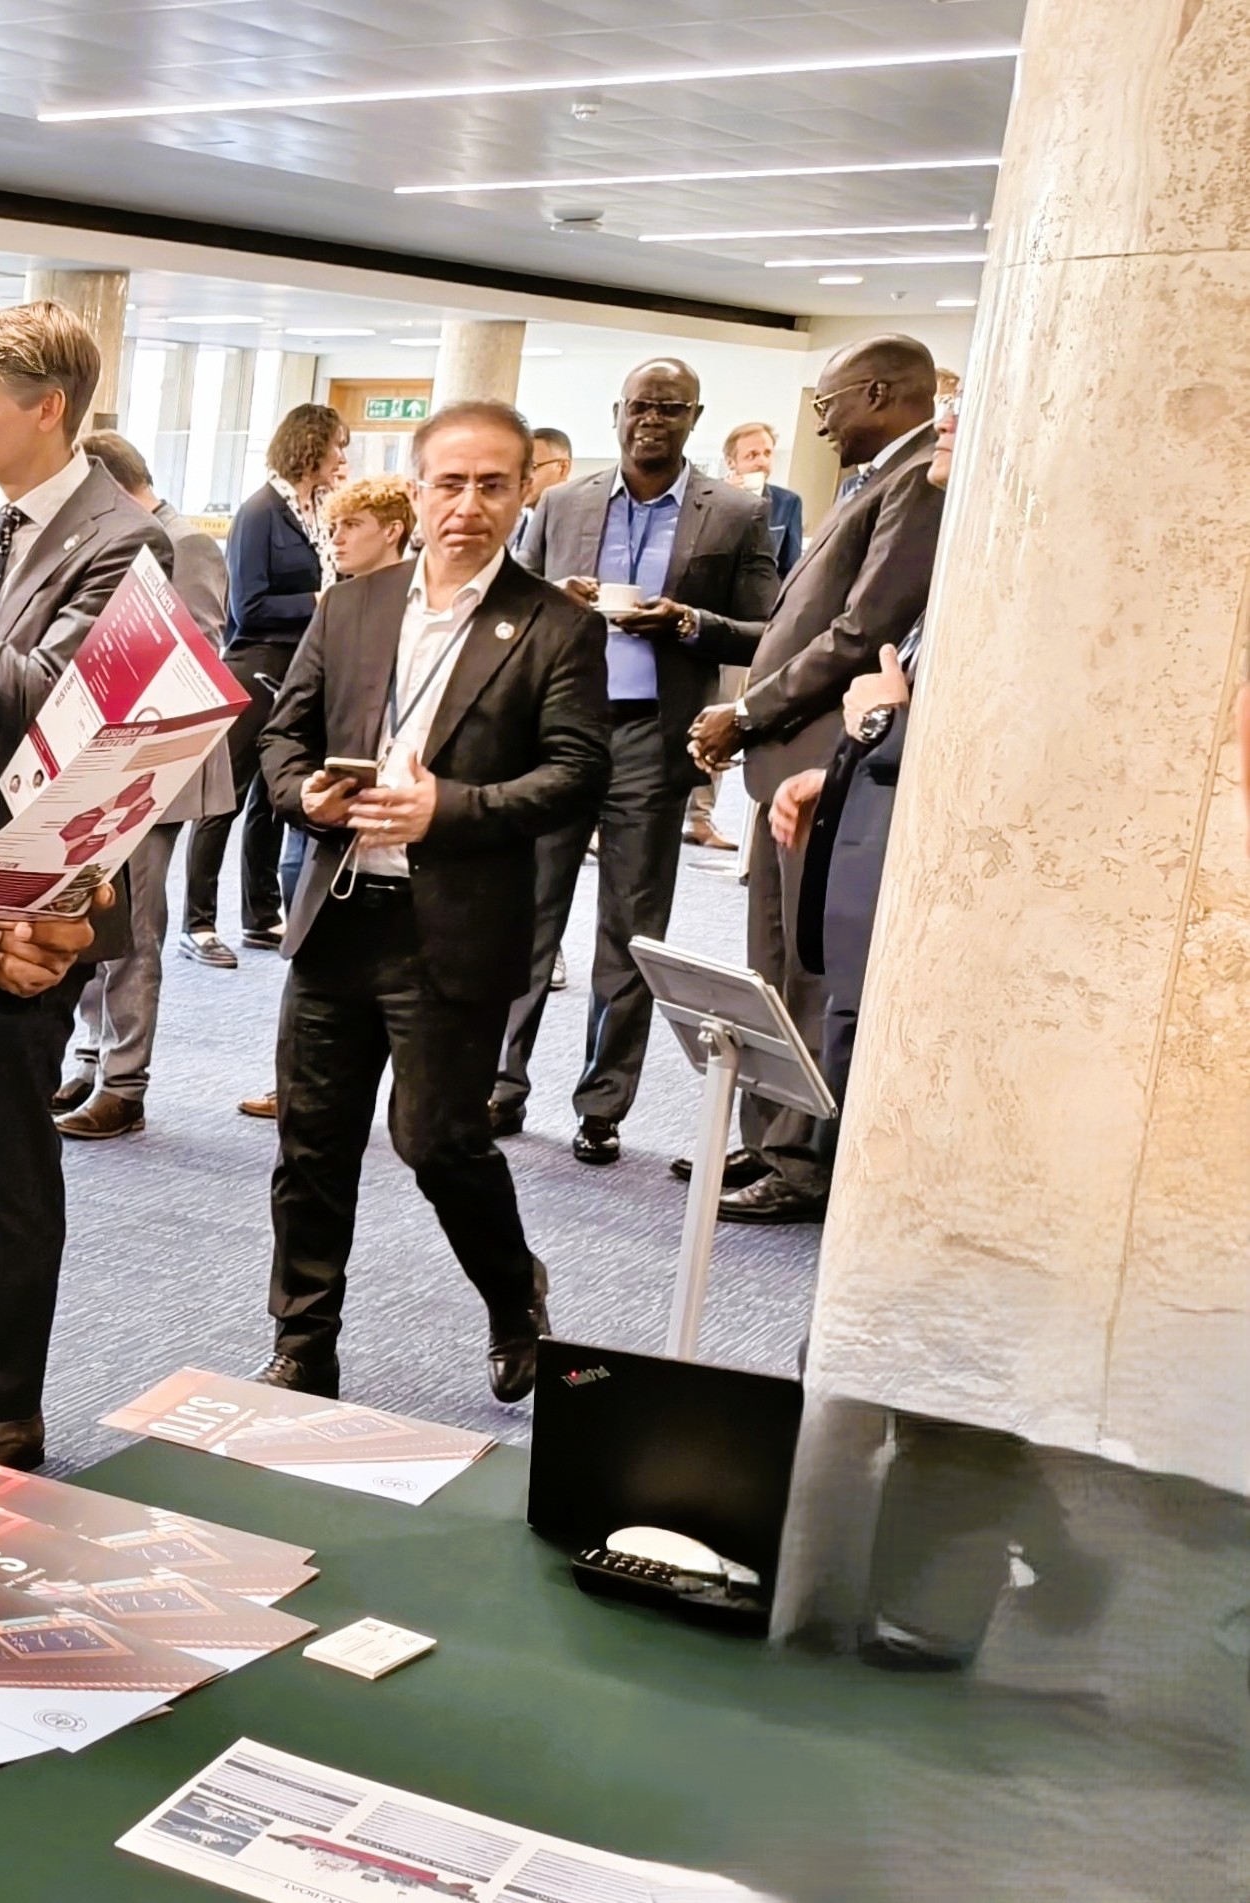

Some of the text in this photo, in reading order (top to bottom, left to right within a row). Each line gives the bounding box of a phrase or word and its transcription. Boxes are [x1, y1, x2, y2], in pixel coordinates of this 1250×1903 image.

[156, 586, 175, 615] FACTS
[55, 670, 77, 708] HISTORY
[148, 1396, 240, 1440] SJTU
